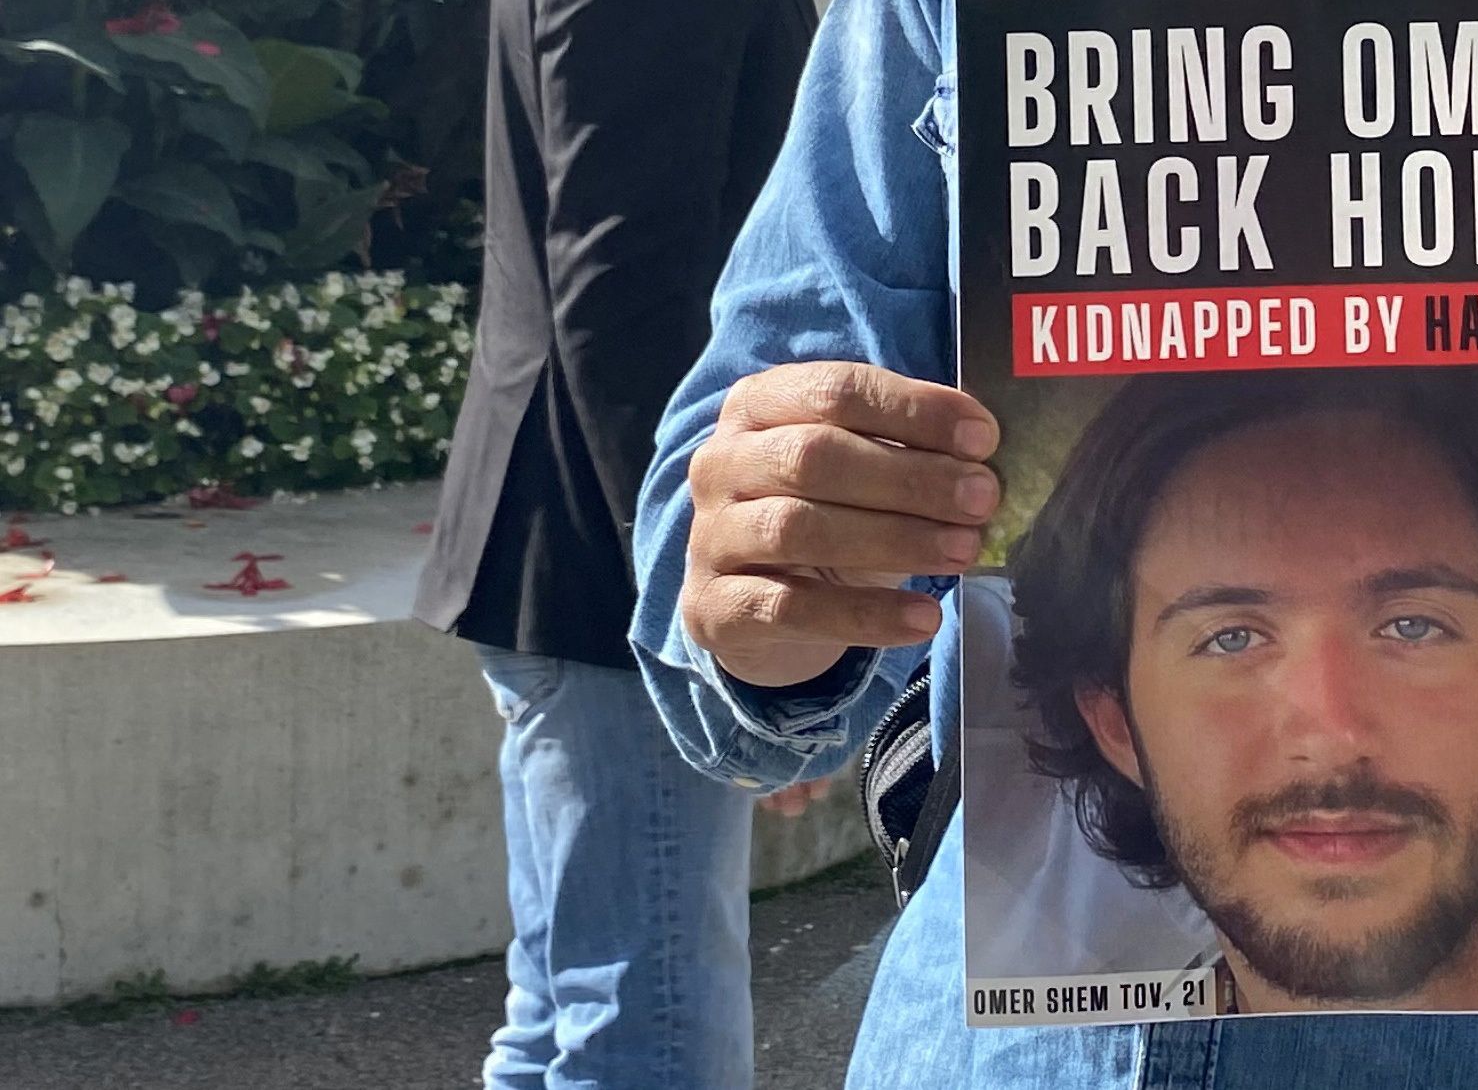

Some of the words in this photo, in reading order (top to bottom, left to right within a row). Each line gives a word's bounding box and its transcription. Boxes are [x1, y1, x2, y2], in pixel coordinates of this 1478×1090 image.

[1006, 24, 1294, 147] BRING
[1009, 154, 1274, 278] BACK
[1031, 297, 1316, 363] KIDNAPPED
[1344, 295, 1403, 354] BY
[973, 988, 1036, 1015] OMER
[1046, 985, 1109, 1014] SHEM
[1119, 982, 1171, 1011] TOV,
[1182, 979, 1206, 1007] 21
